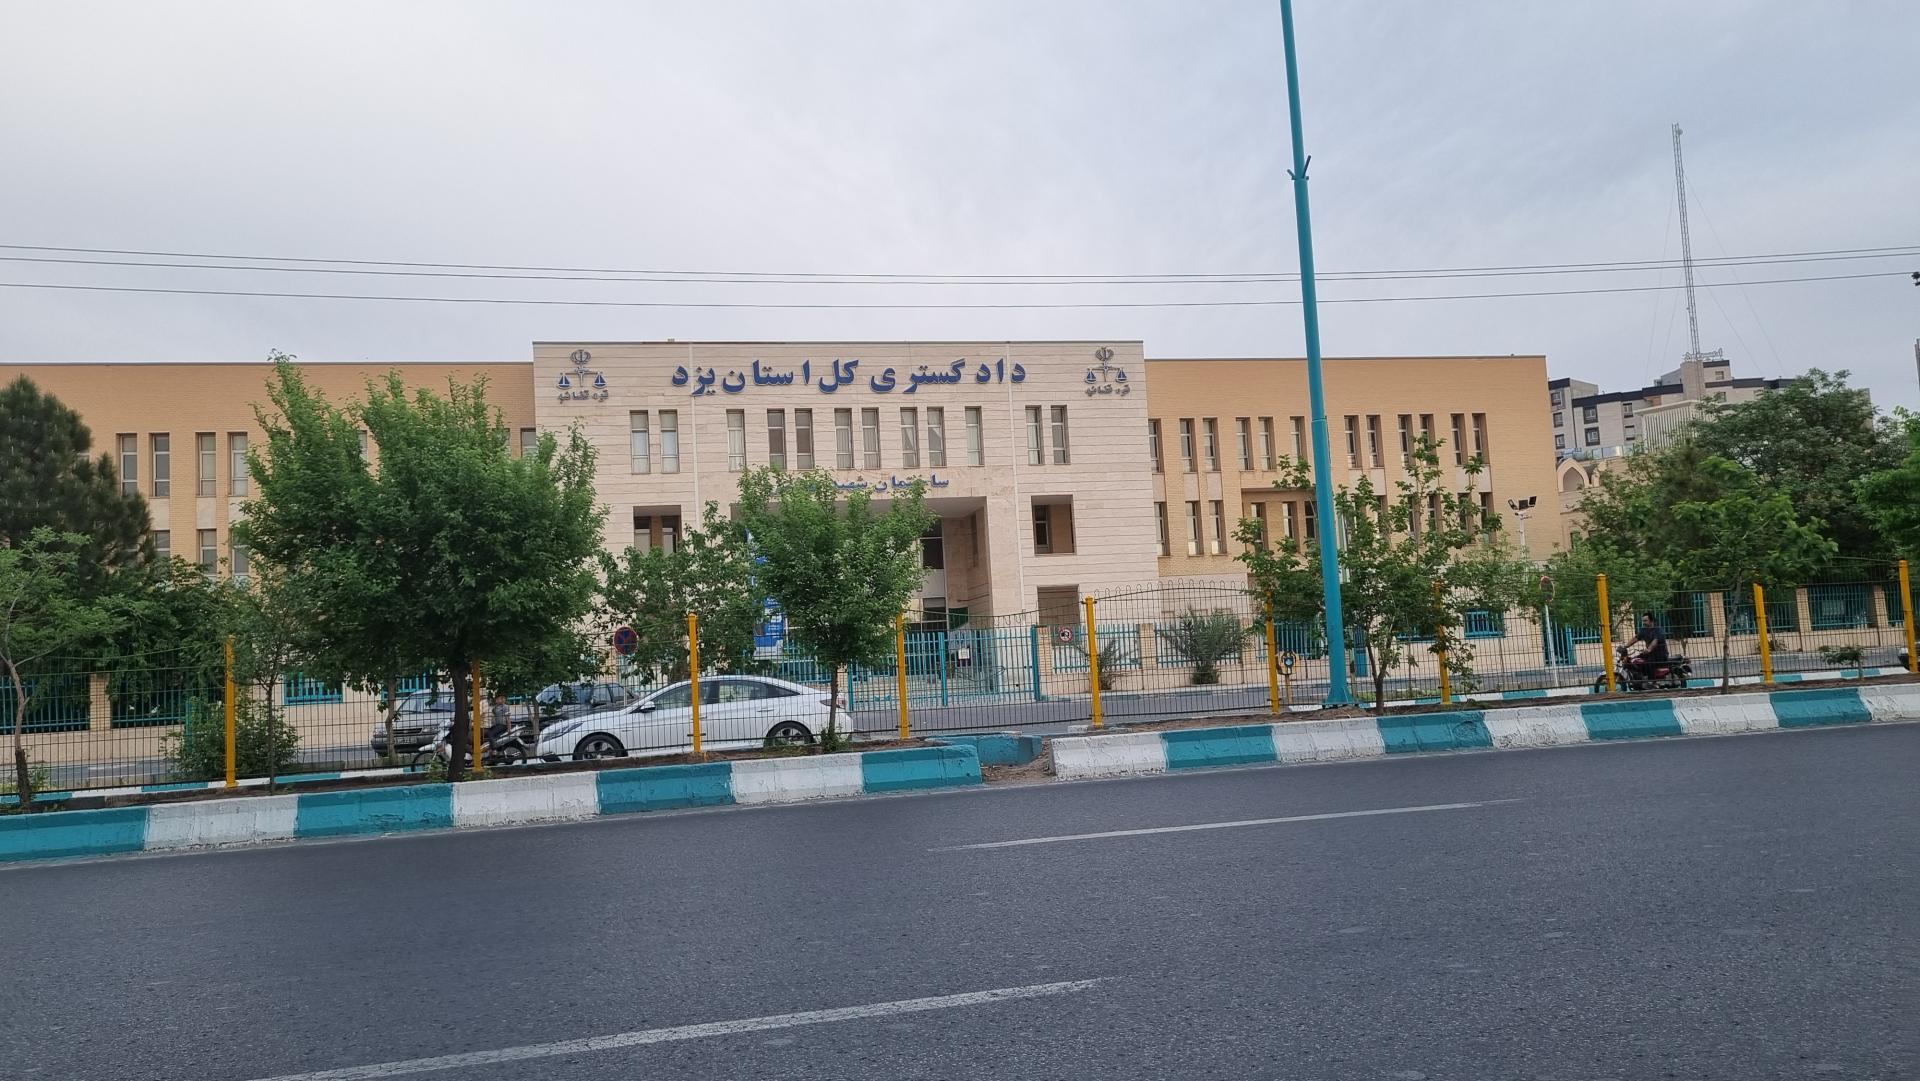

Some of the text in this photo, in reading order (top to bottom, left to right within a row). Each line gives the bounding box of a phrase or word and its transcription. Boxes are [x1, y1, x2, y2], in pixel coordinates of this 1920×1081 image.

[671, 358, 1026, 397] دادگستری کل استان یزد
